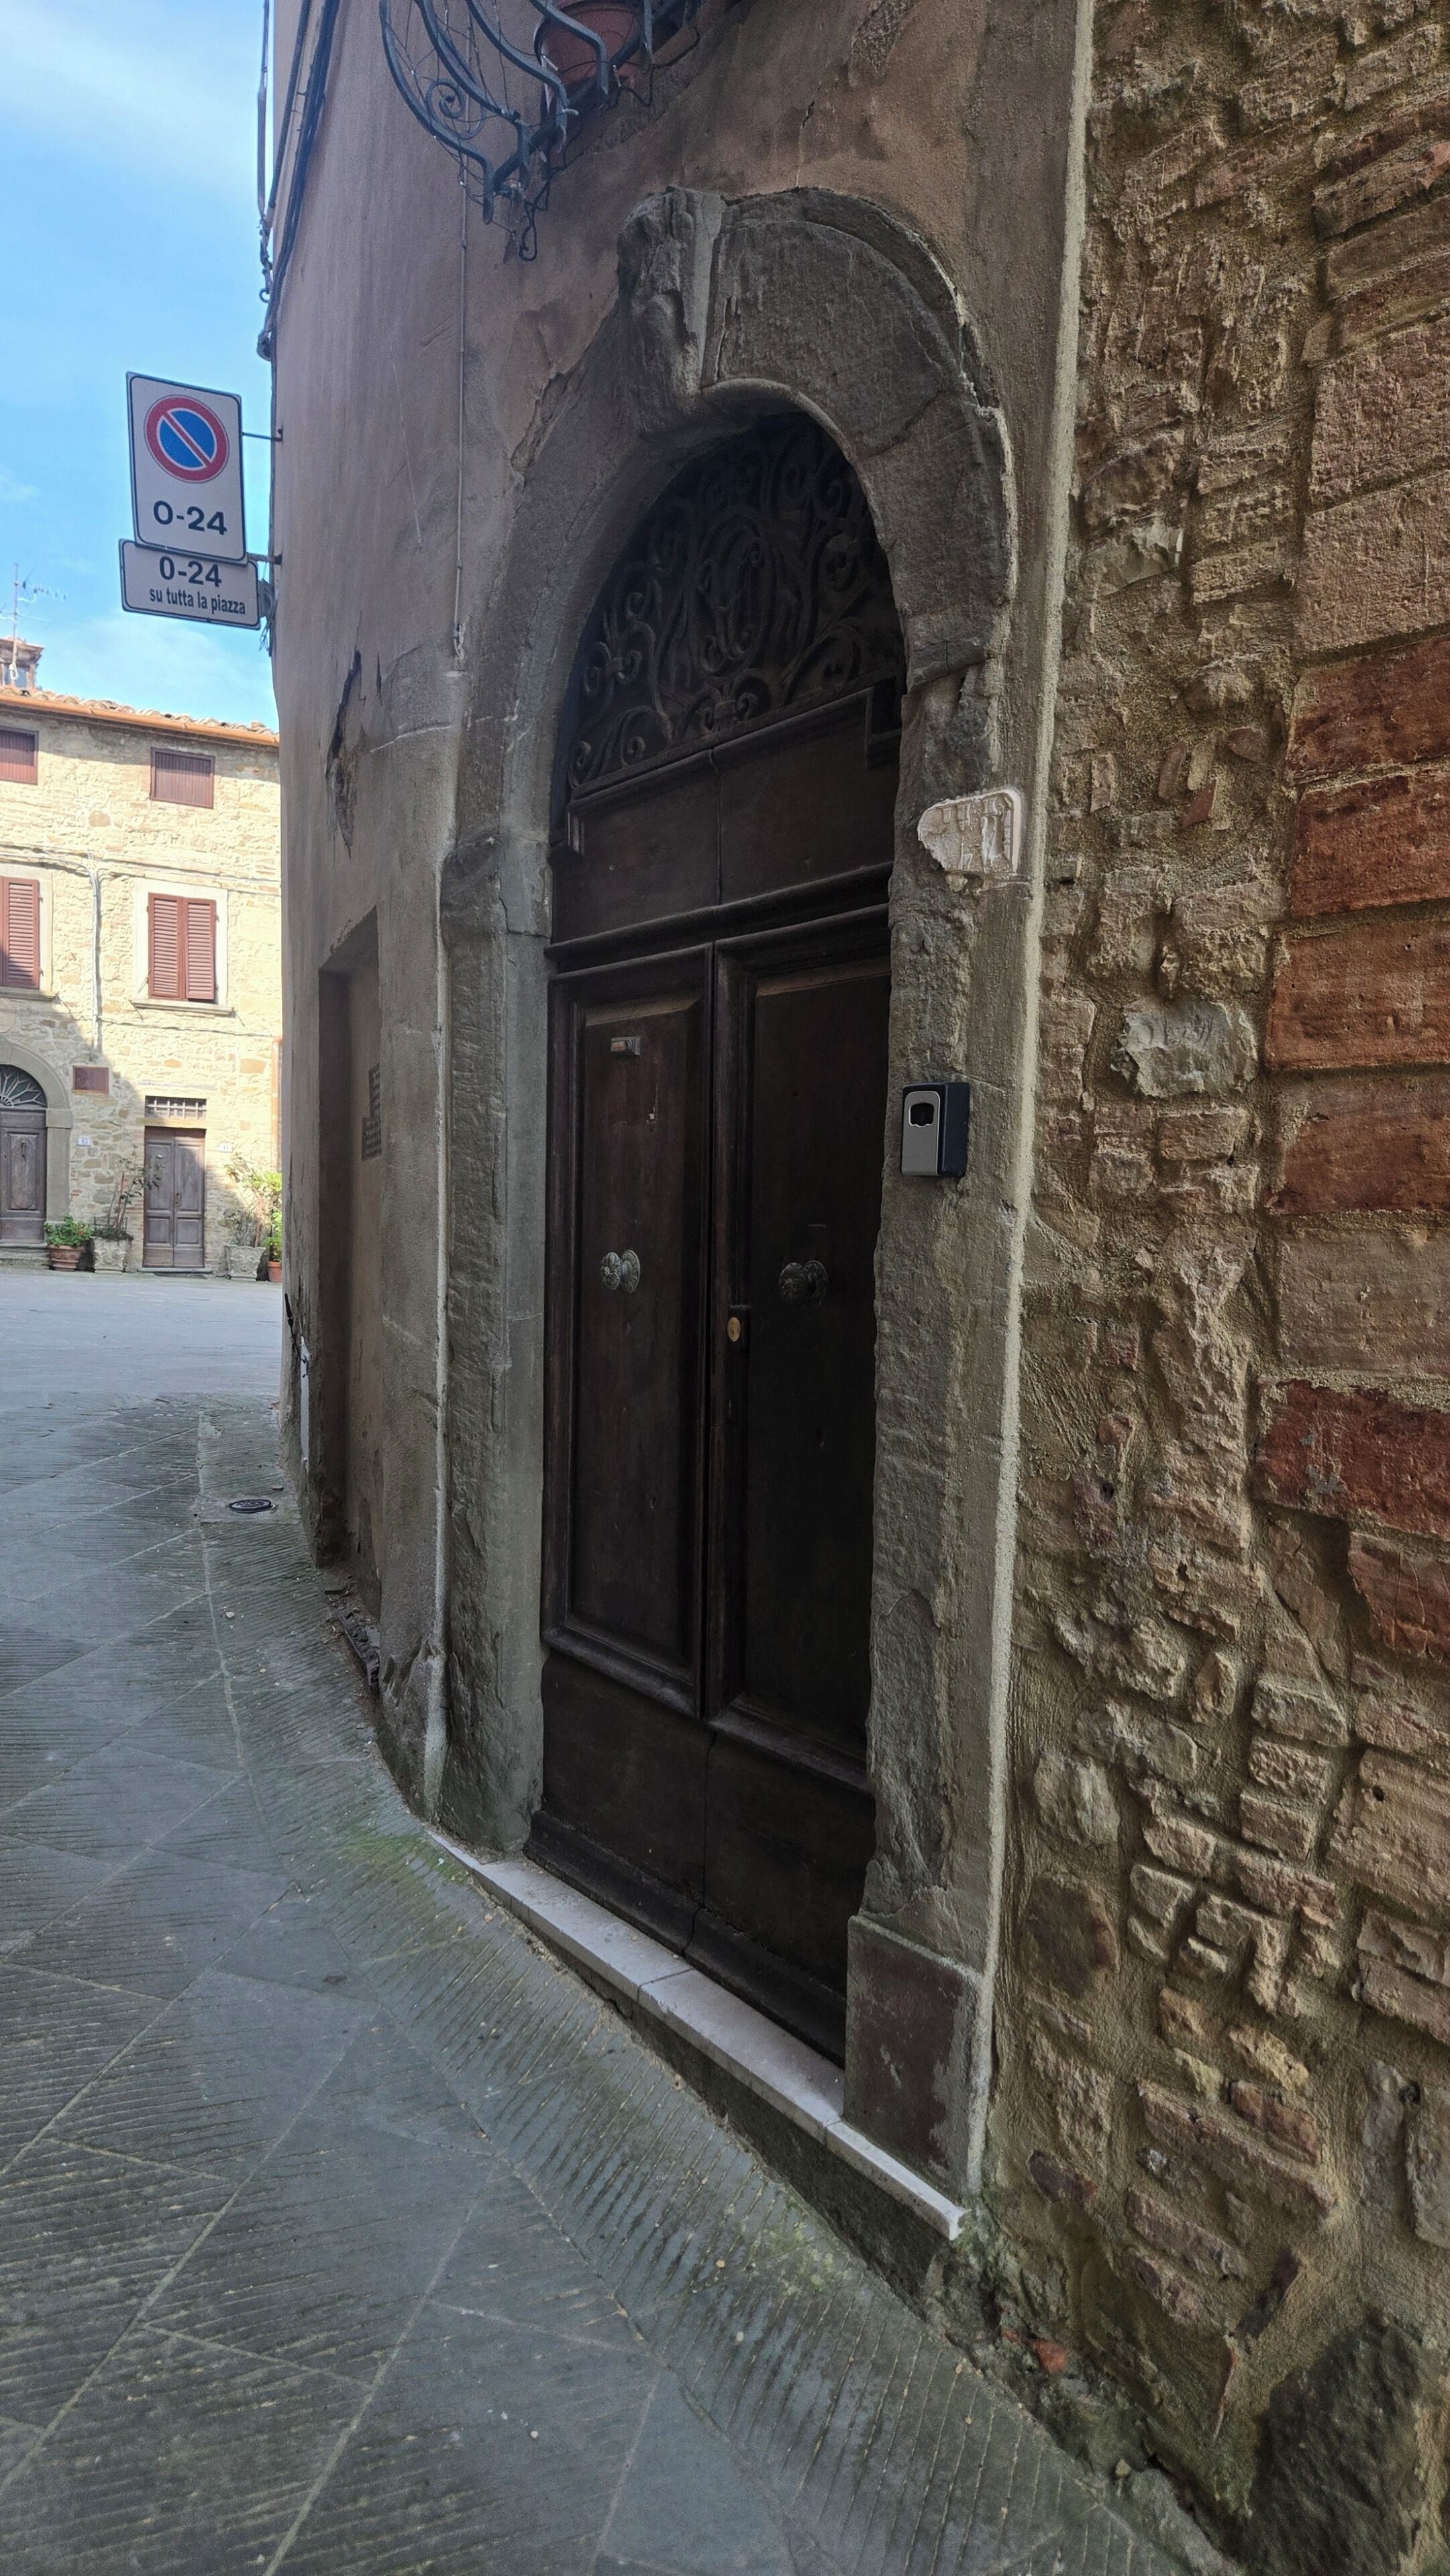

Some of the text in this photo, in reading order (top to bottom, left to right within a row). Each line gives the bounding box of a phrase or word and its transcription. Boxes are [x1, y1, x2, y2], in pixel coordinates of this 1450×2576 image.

[154, 500, 227, 535] 0-24
[160, 556, 222, 587] 0-24
[150, 587, 246, 614] su tutta la piazza
